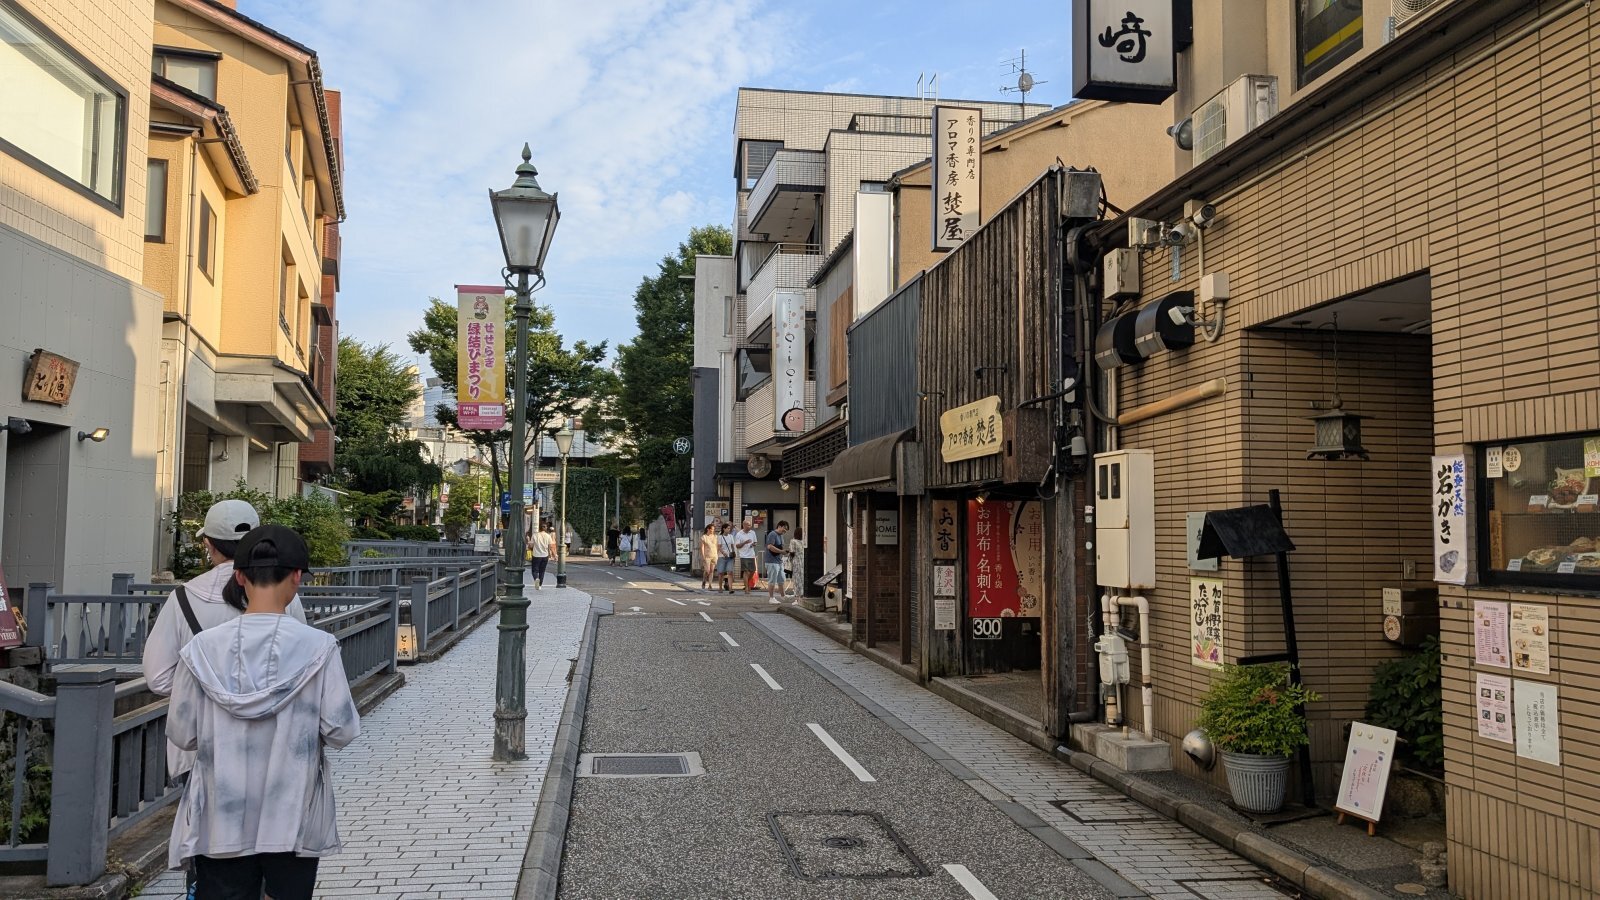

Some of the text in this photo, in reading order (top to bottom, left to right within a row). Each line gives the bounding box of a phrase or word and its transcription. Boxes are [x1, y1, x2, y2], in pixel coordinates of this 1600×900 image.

[966, 115, 976, 180] 香りの専門店
[940, 119, 964, 242] アロマ香房 焚屋
[484, 322, 494, 368] せせらぎ
[1436, 464, 1454, 545] 岩がき
[1452, 460, 1464, 517] 能登天然
[937, 507, 955, 551] お香
[1028, 507, 1041, 552] お車用
[944, 567, 954, 594] 金沢の
[976, 507, 992, 605] お財布・名刺入
[974, 619, 1001, 636] 300
